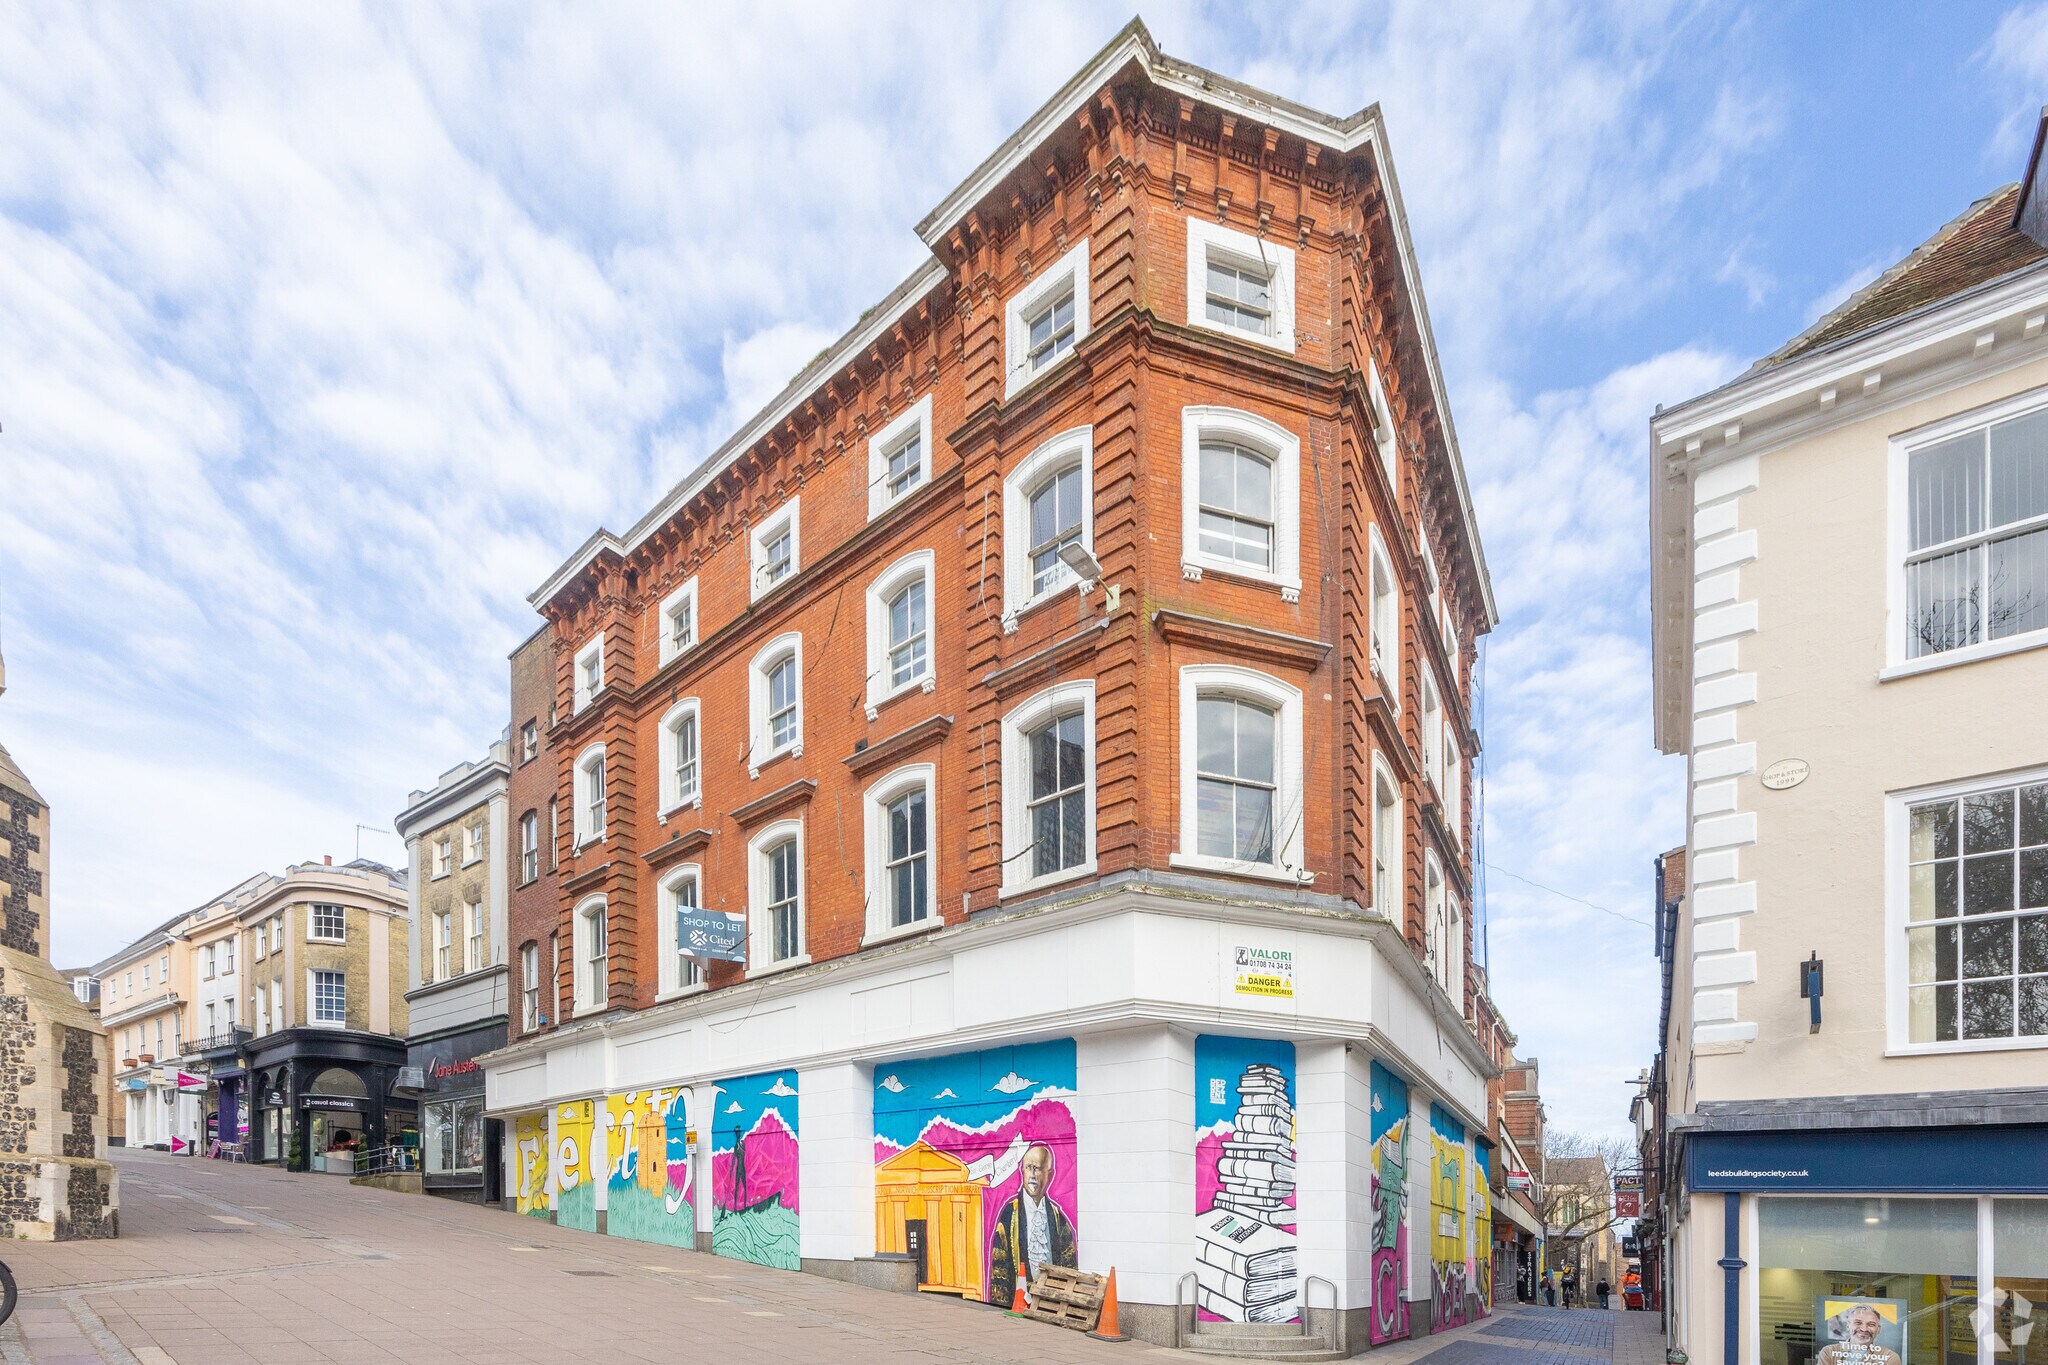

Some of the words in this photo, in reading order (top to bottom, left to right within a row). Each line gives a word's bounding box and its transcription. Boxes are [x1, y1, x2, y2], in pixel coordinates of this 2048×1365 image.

[683, 917, 709, 928] SHOP
[712, 920, 724, 930] TO
[727, 923, 741, 932] LET
[709, 934, 735, 946] Cited
[1250, 948, 1292, 961] VALORI
[1250, 960, 1267, 968] 01708
[1248, 977, 1281, 987] DANGER
[1235, 985, 1263, 993] DEMOLITION
[1270, 988, 1293, 996] PROGRESS
[435, 1064, 453, 1078] Jane
[453, 1059, 479, 1075] Austen
[1708, 1170, 1809, 1179] leedsbuildingsociety.co.uk
[1616, 1176, 1640, 1185] PACT
[1236, 1222, 1261, 1243] LITERATURE
[1839, 1341, 1867, 1351] Time
[1869, 1344, 1882, 1352] to
[1832, 1350, 1862, 1358] move
[1864, 1353, 1890, 1361] your
